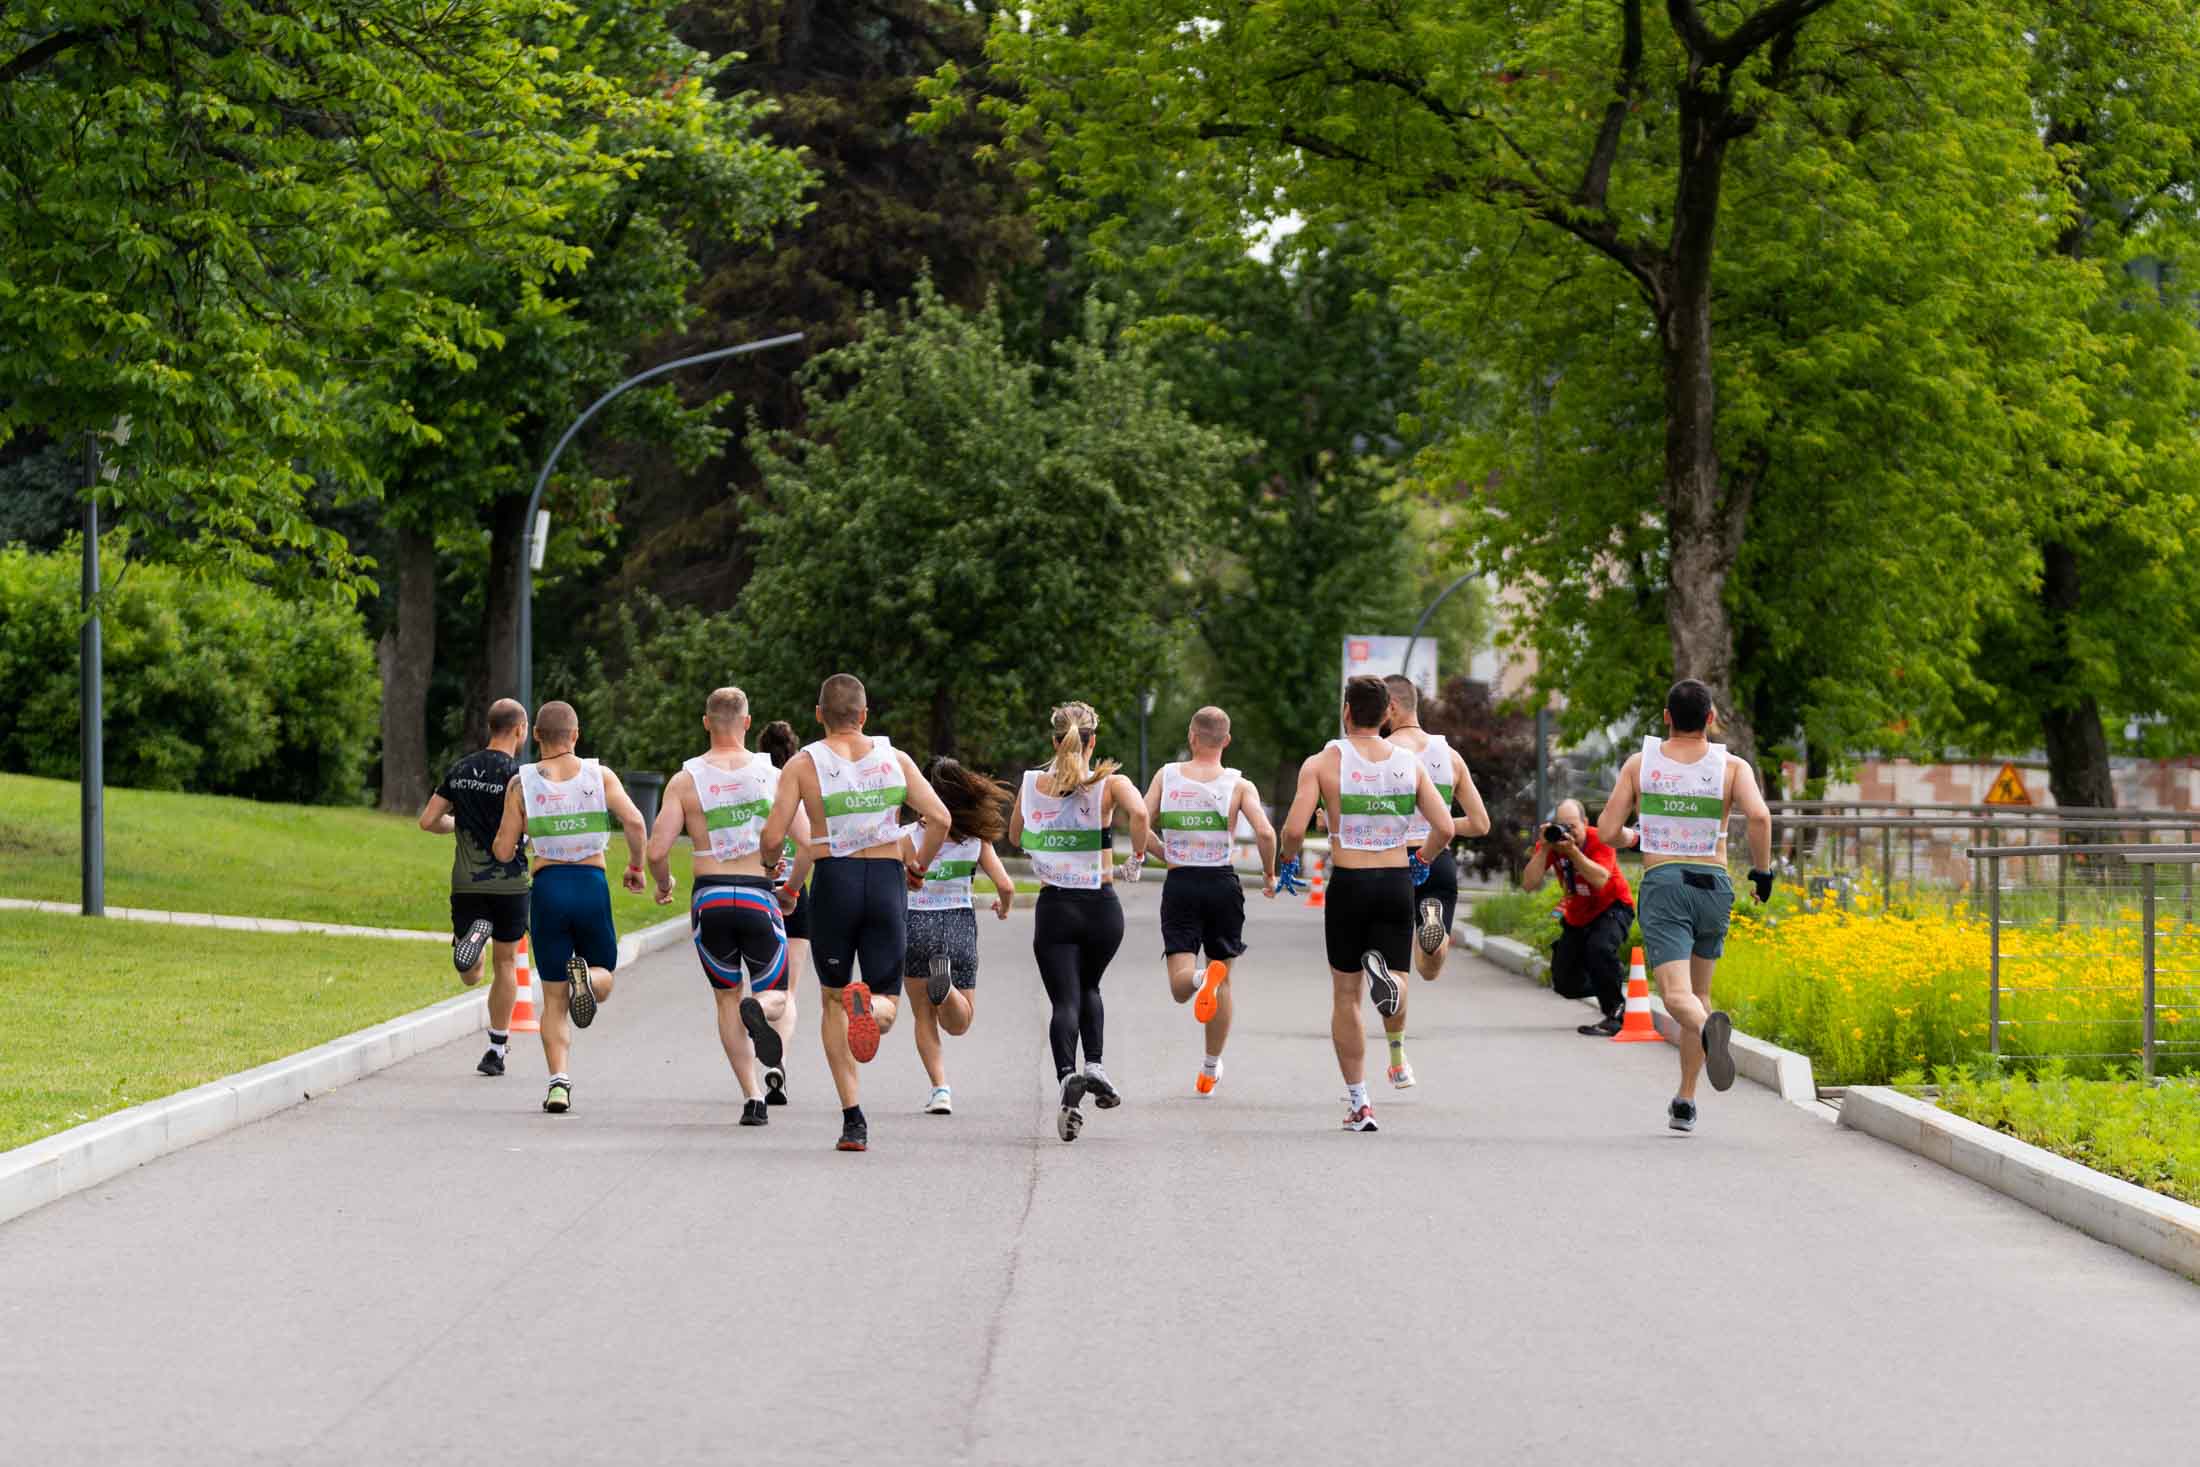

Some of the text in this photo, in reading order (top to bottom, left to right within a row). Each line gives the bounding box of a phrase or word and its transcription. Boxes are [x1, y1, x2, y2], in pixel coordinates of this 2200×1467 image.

[1663, 800, 1698, 813] 102-4
[553, 817, 587, 832] 102-3
[1182, 815, 1213, 826] 102-9
[1043, 835, 1077, 848] 102-2
